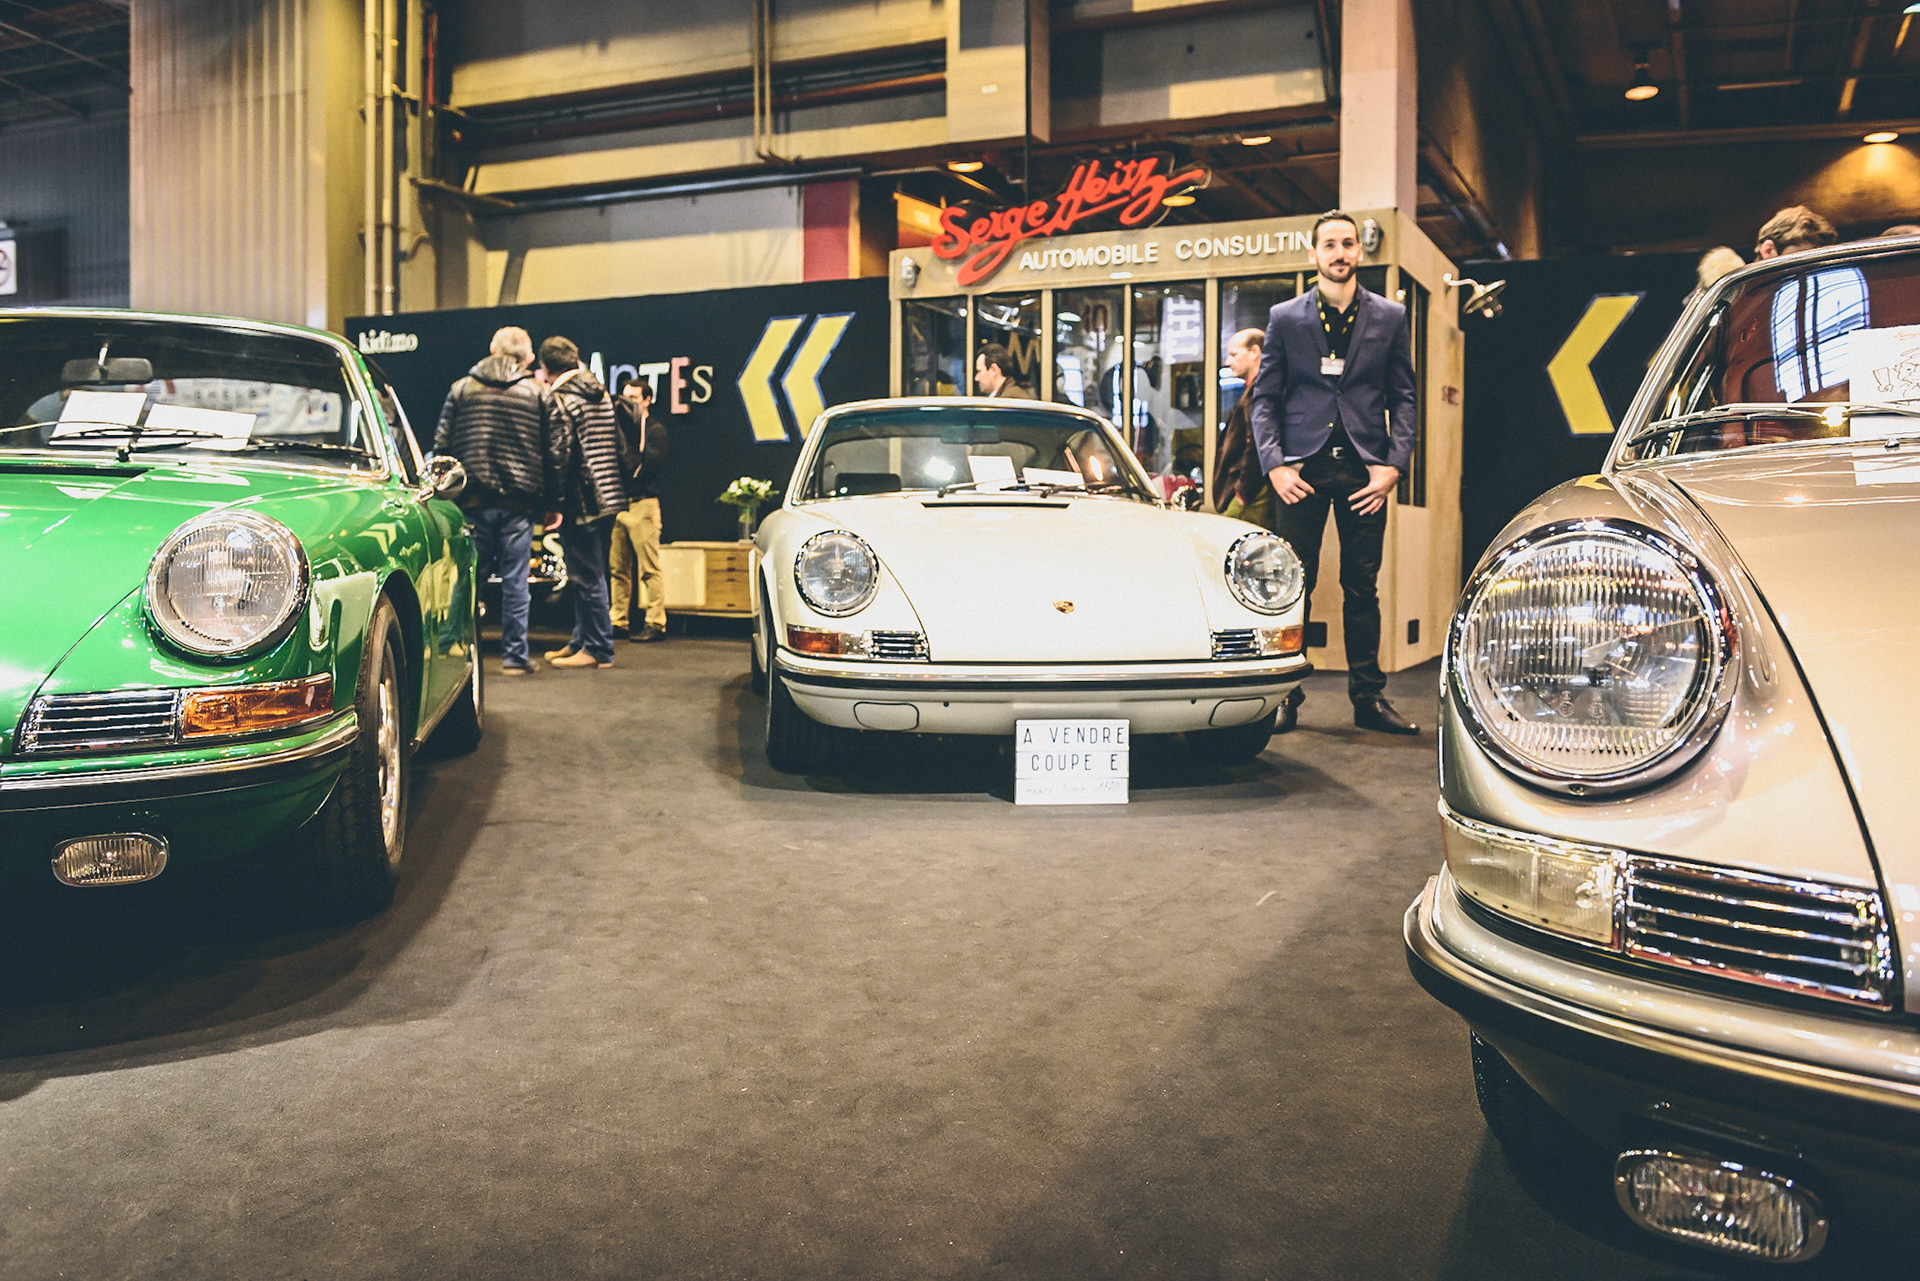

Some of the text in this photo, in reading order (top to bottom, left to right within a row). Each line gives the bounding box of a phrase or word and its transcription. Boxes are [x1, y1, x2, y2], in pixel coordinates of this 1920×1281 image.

[932, 157, 1204, 286] Serge Heitz
[1018, 230, 1312, 271] AUTOMOBILE CONSULTIN
[1023, 726, 1125, 744] A VENDRE
[1031, 753, 1118, 771] COUPE E
